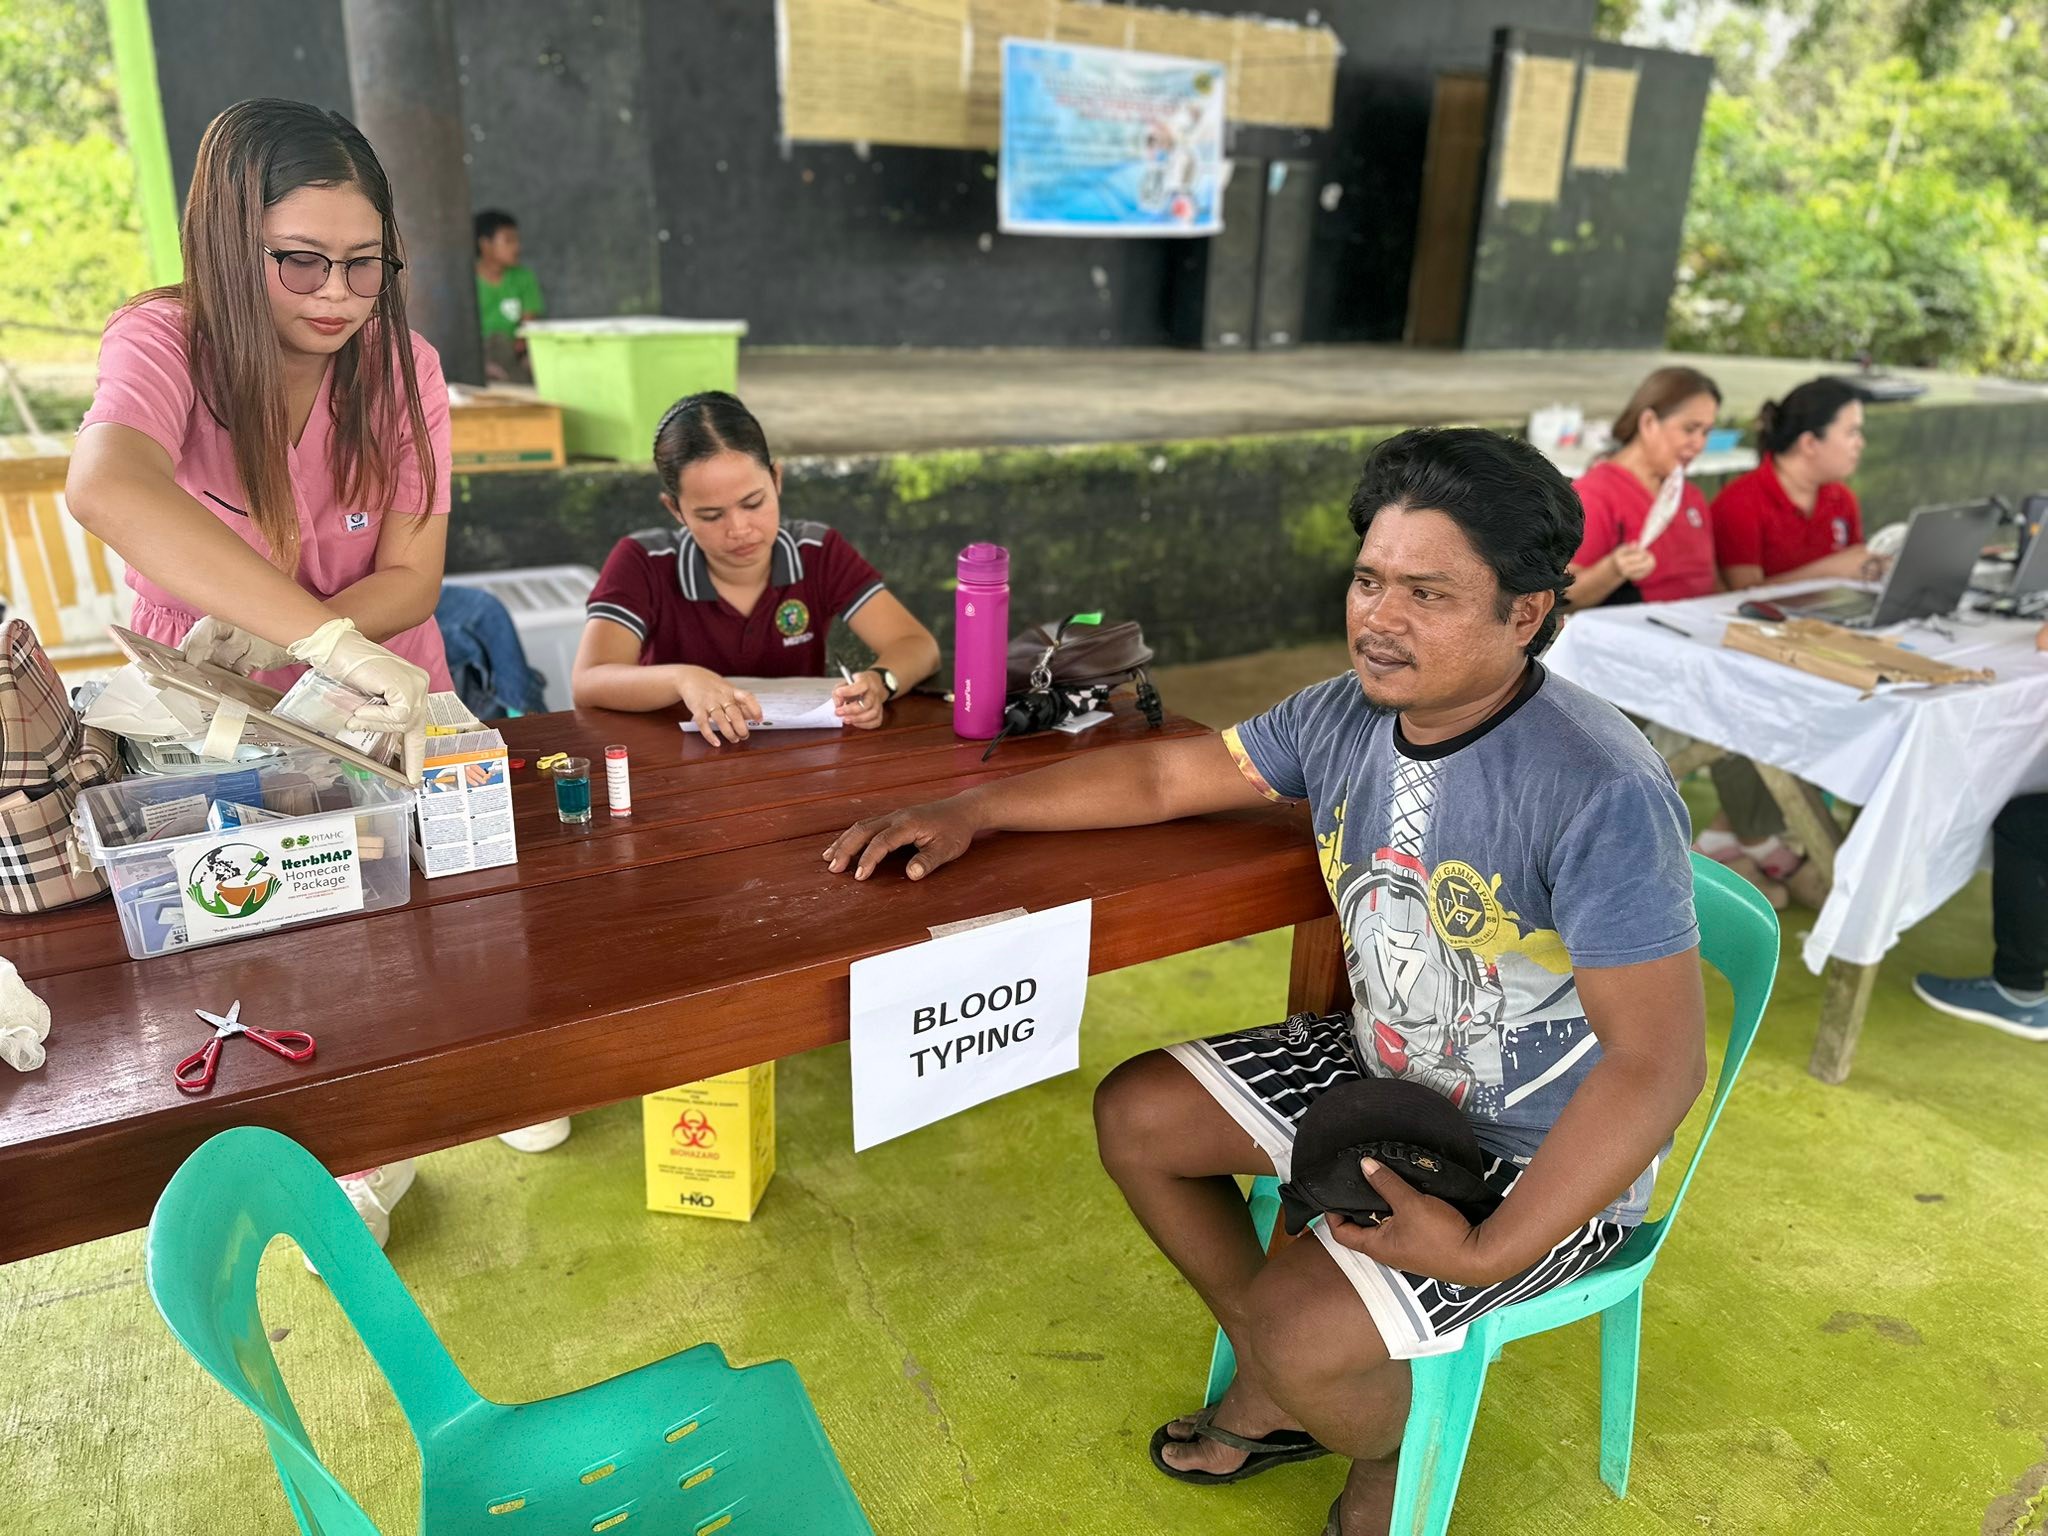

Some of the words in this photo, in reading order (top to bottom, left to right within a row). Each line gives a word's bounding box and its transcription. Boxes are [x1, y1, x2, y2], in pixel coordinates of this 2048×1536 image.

[311, 831, 344, 843] PITAHC
[281, 849, 352, 870] HerbMAP
[285, 863, 350, 881] Homecare
[293, 875, 345, 892] Package
[1432, 871, 1443, 891] TAU
[1443, 867, 1480, 890] GAMMA
[1479, 890, 1493, 912] PHI
[913, 977, 1037, 1035] BLOOD
[909, 1017, 1035, 1077] TYPING
[670, 1148, 720, 1160] BIOHAZARD
